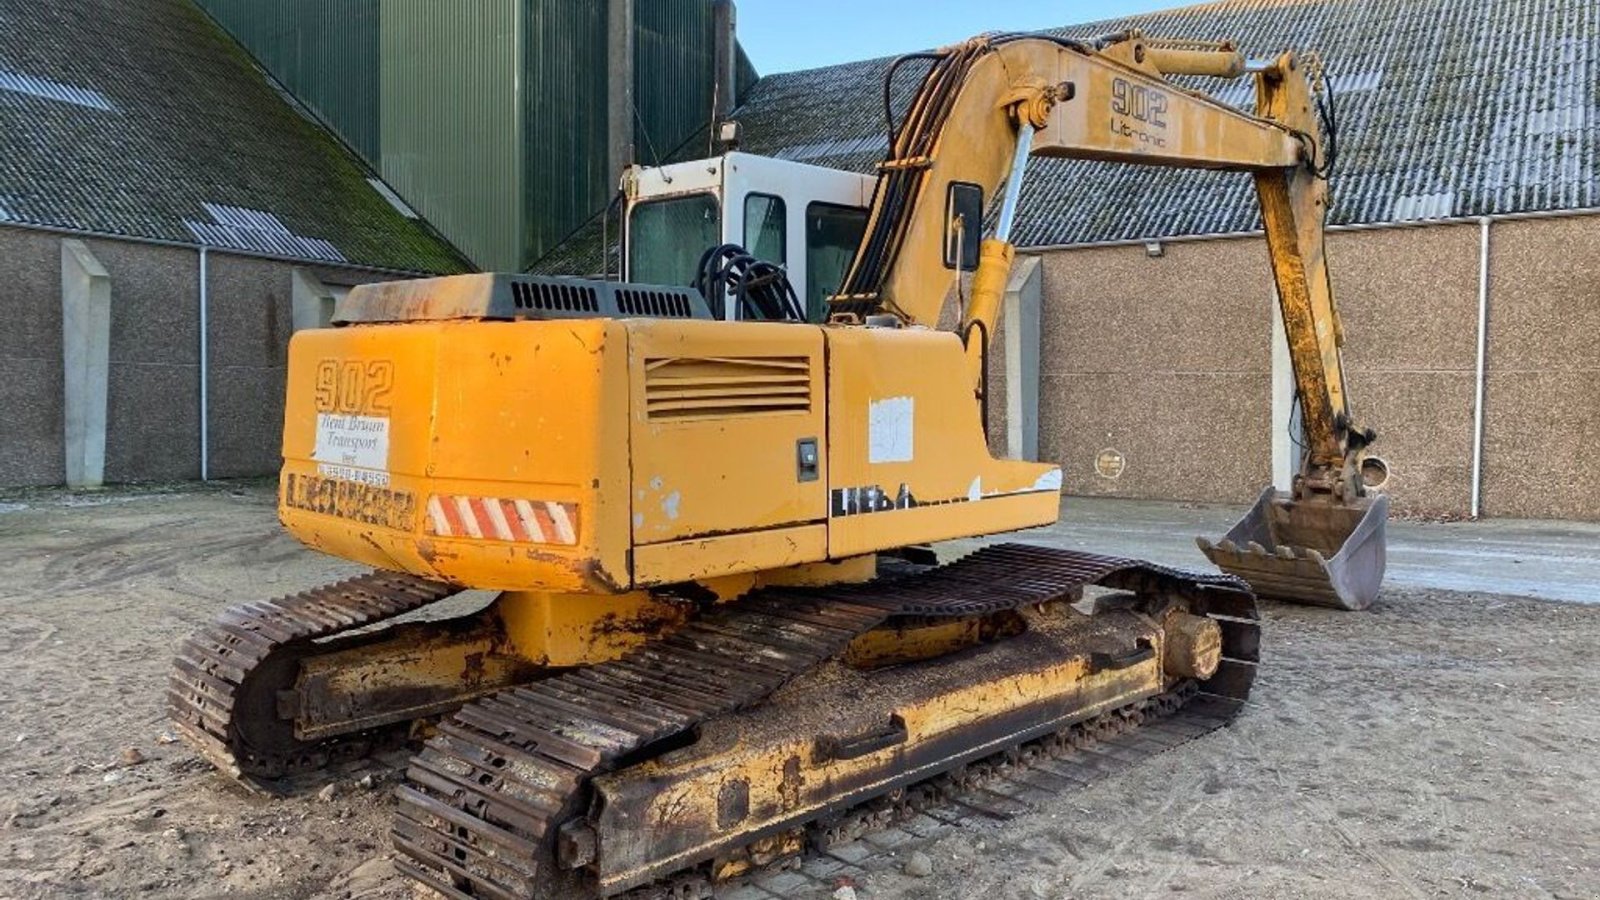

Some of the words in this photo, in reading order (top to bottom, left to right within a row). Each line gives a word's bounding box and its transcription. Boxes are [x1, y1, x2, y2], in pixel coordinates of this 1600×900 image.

[1112, 77, 1168, 129] 902
[1110, 117, 1167, 149] Litronic
[314, 359, 394, 416] 902
[327, 430, 378, 453] Transport
